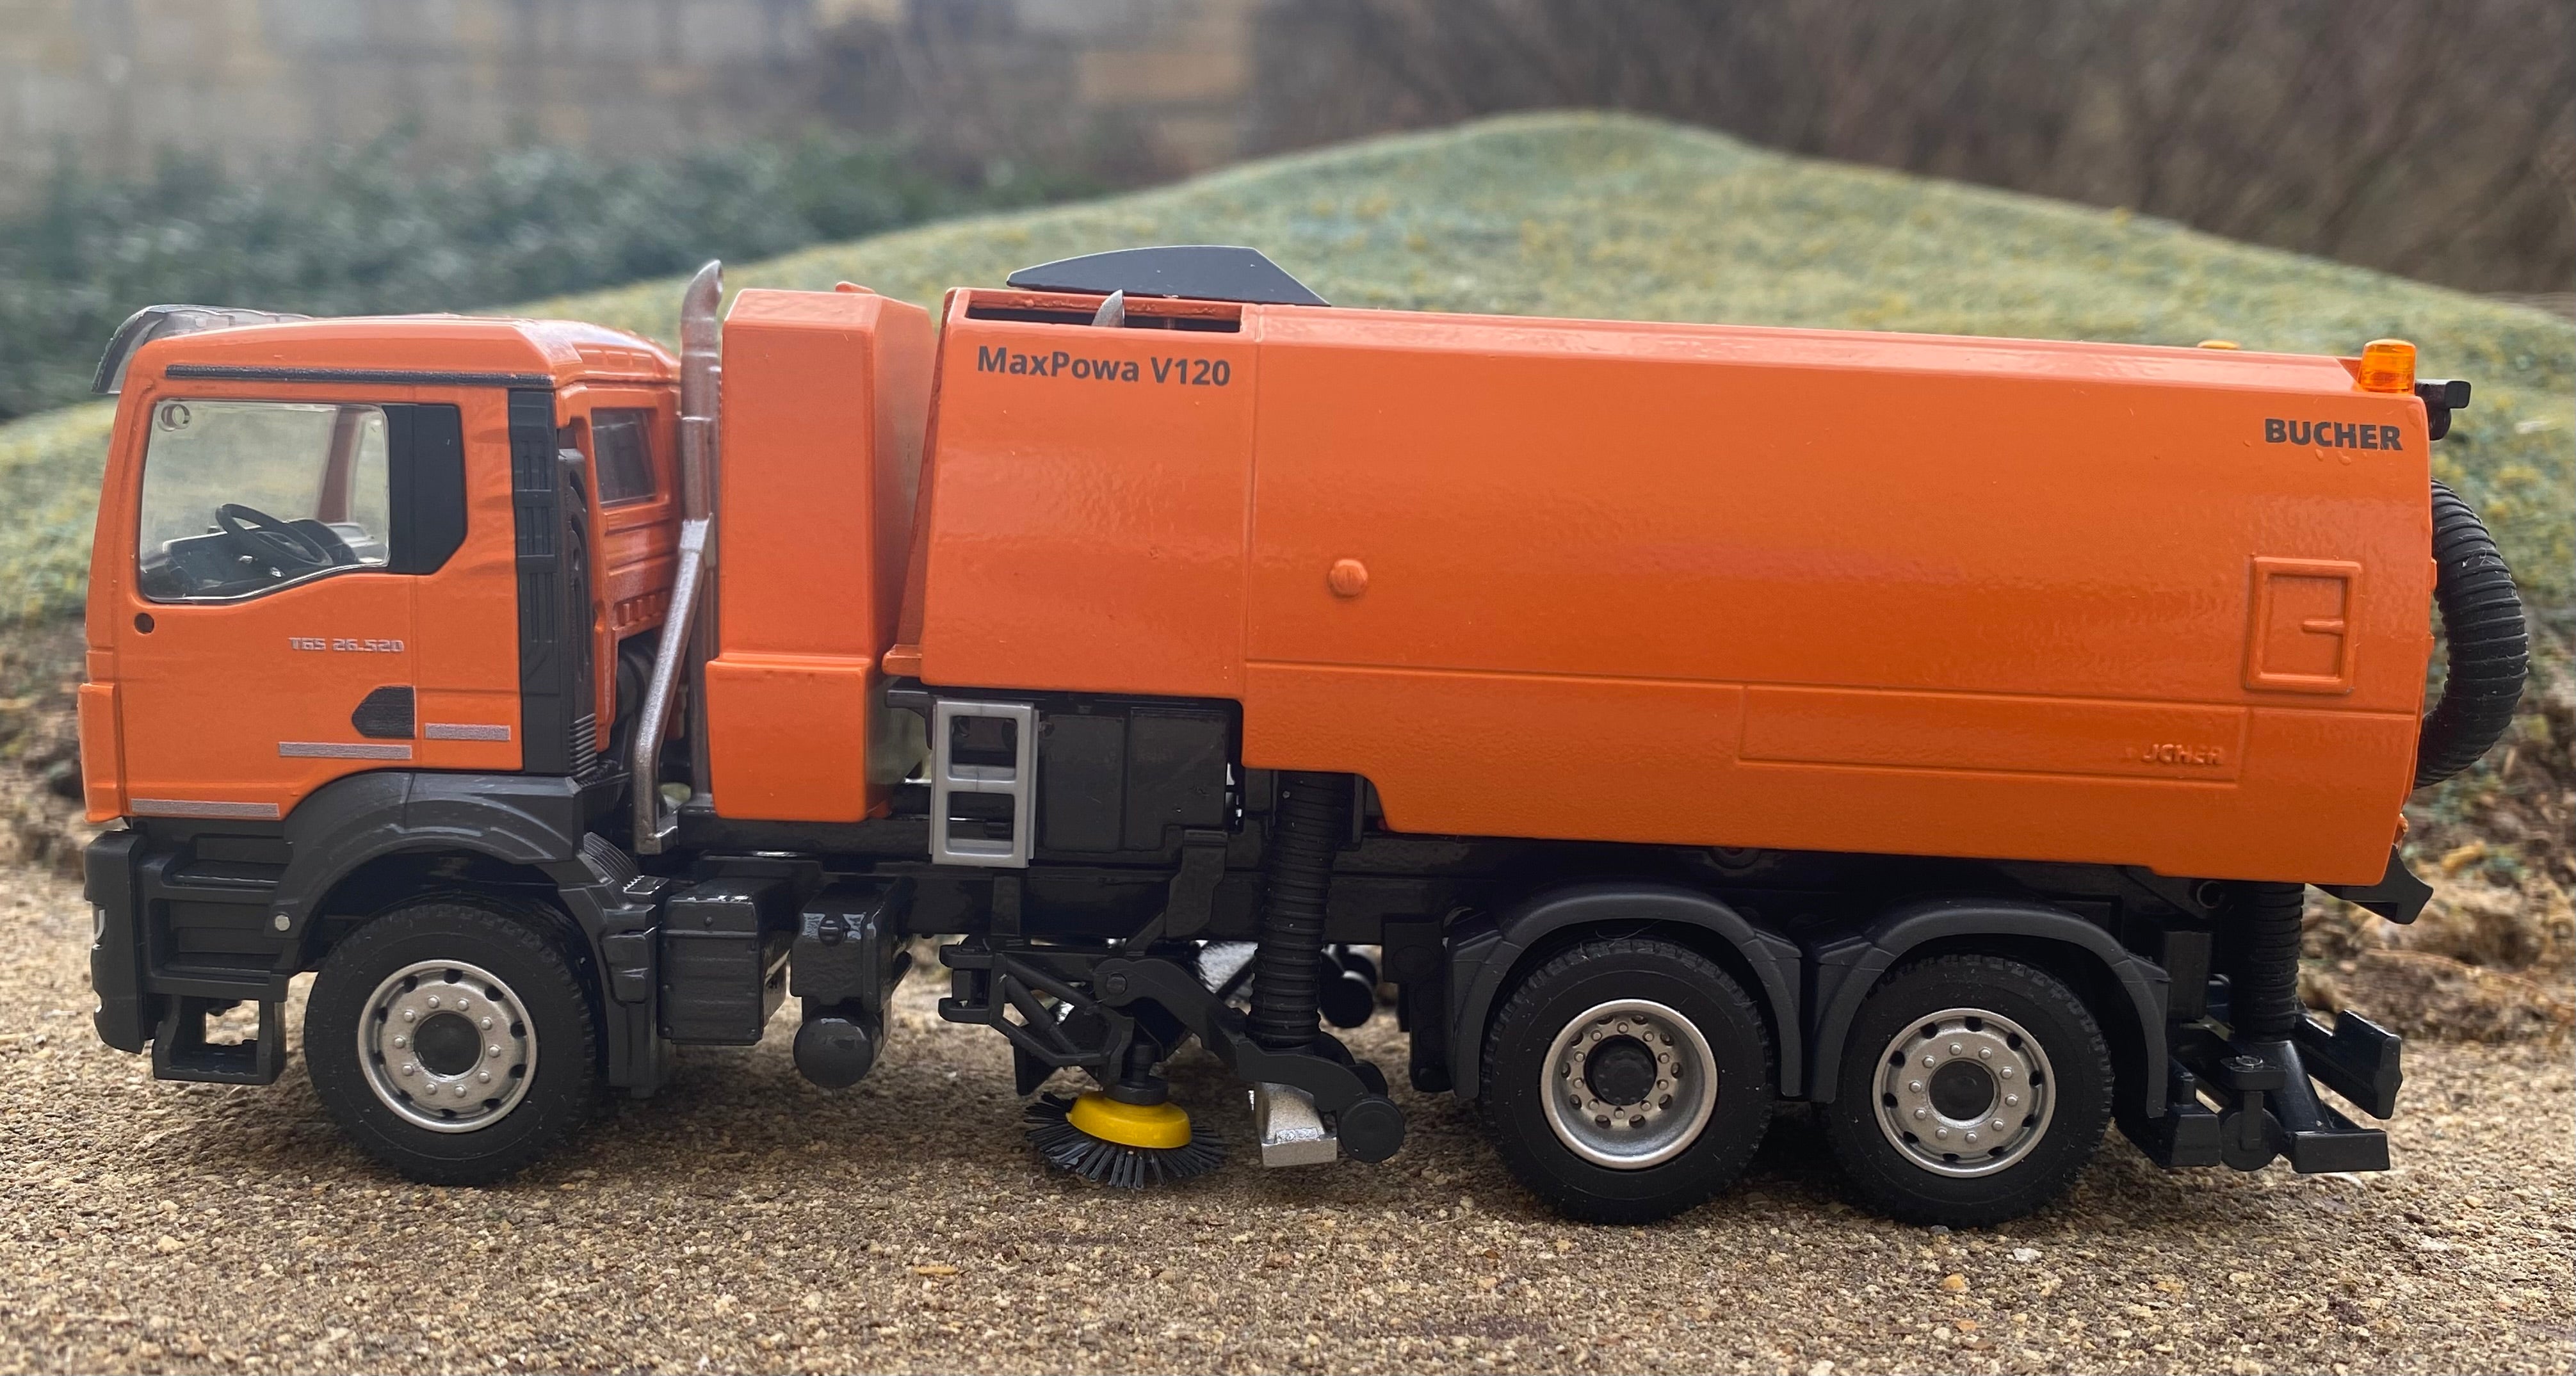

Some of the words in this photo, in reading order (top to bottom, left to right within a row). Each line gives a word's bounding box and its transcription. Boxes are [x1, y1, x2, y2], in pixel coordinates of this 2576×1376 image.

[977, 345, 1139, 382] MaxPowa
[1150, 357, 1231, 386] V120
[2265, 418, 2402, 451] BUCHER
[332, 638, 404, 652] 26.520
